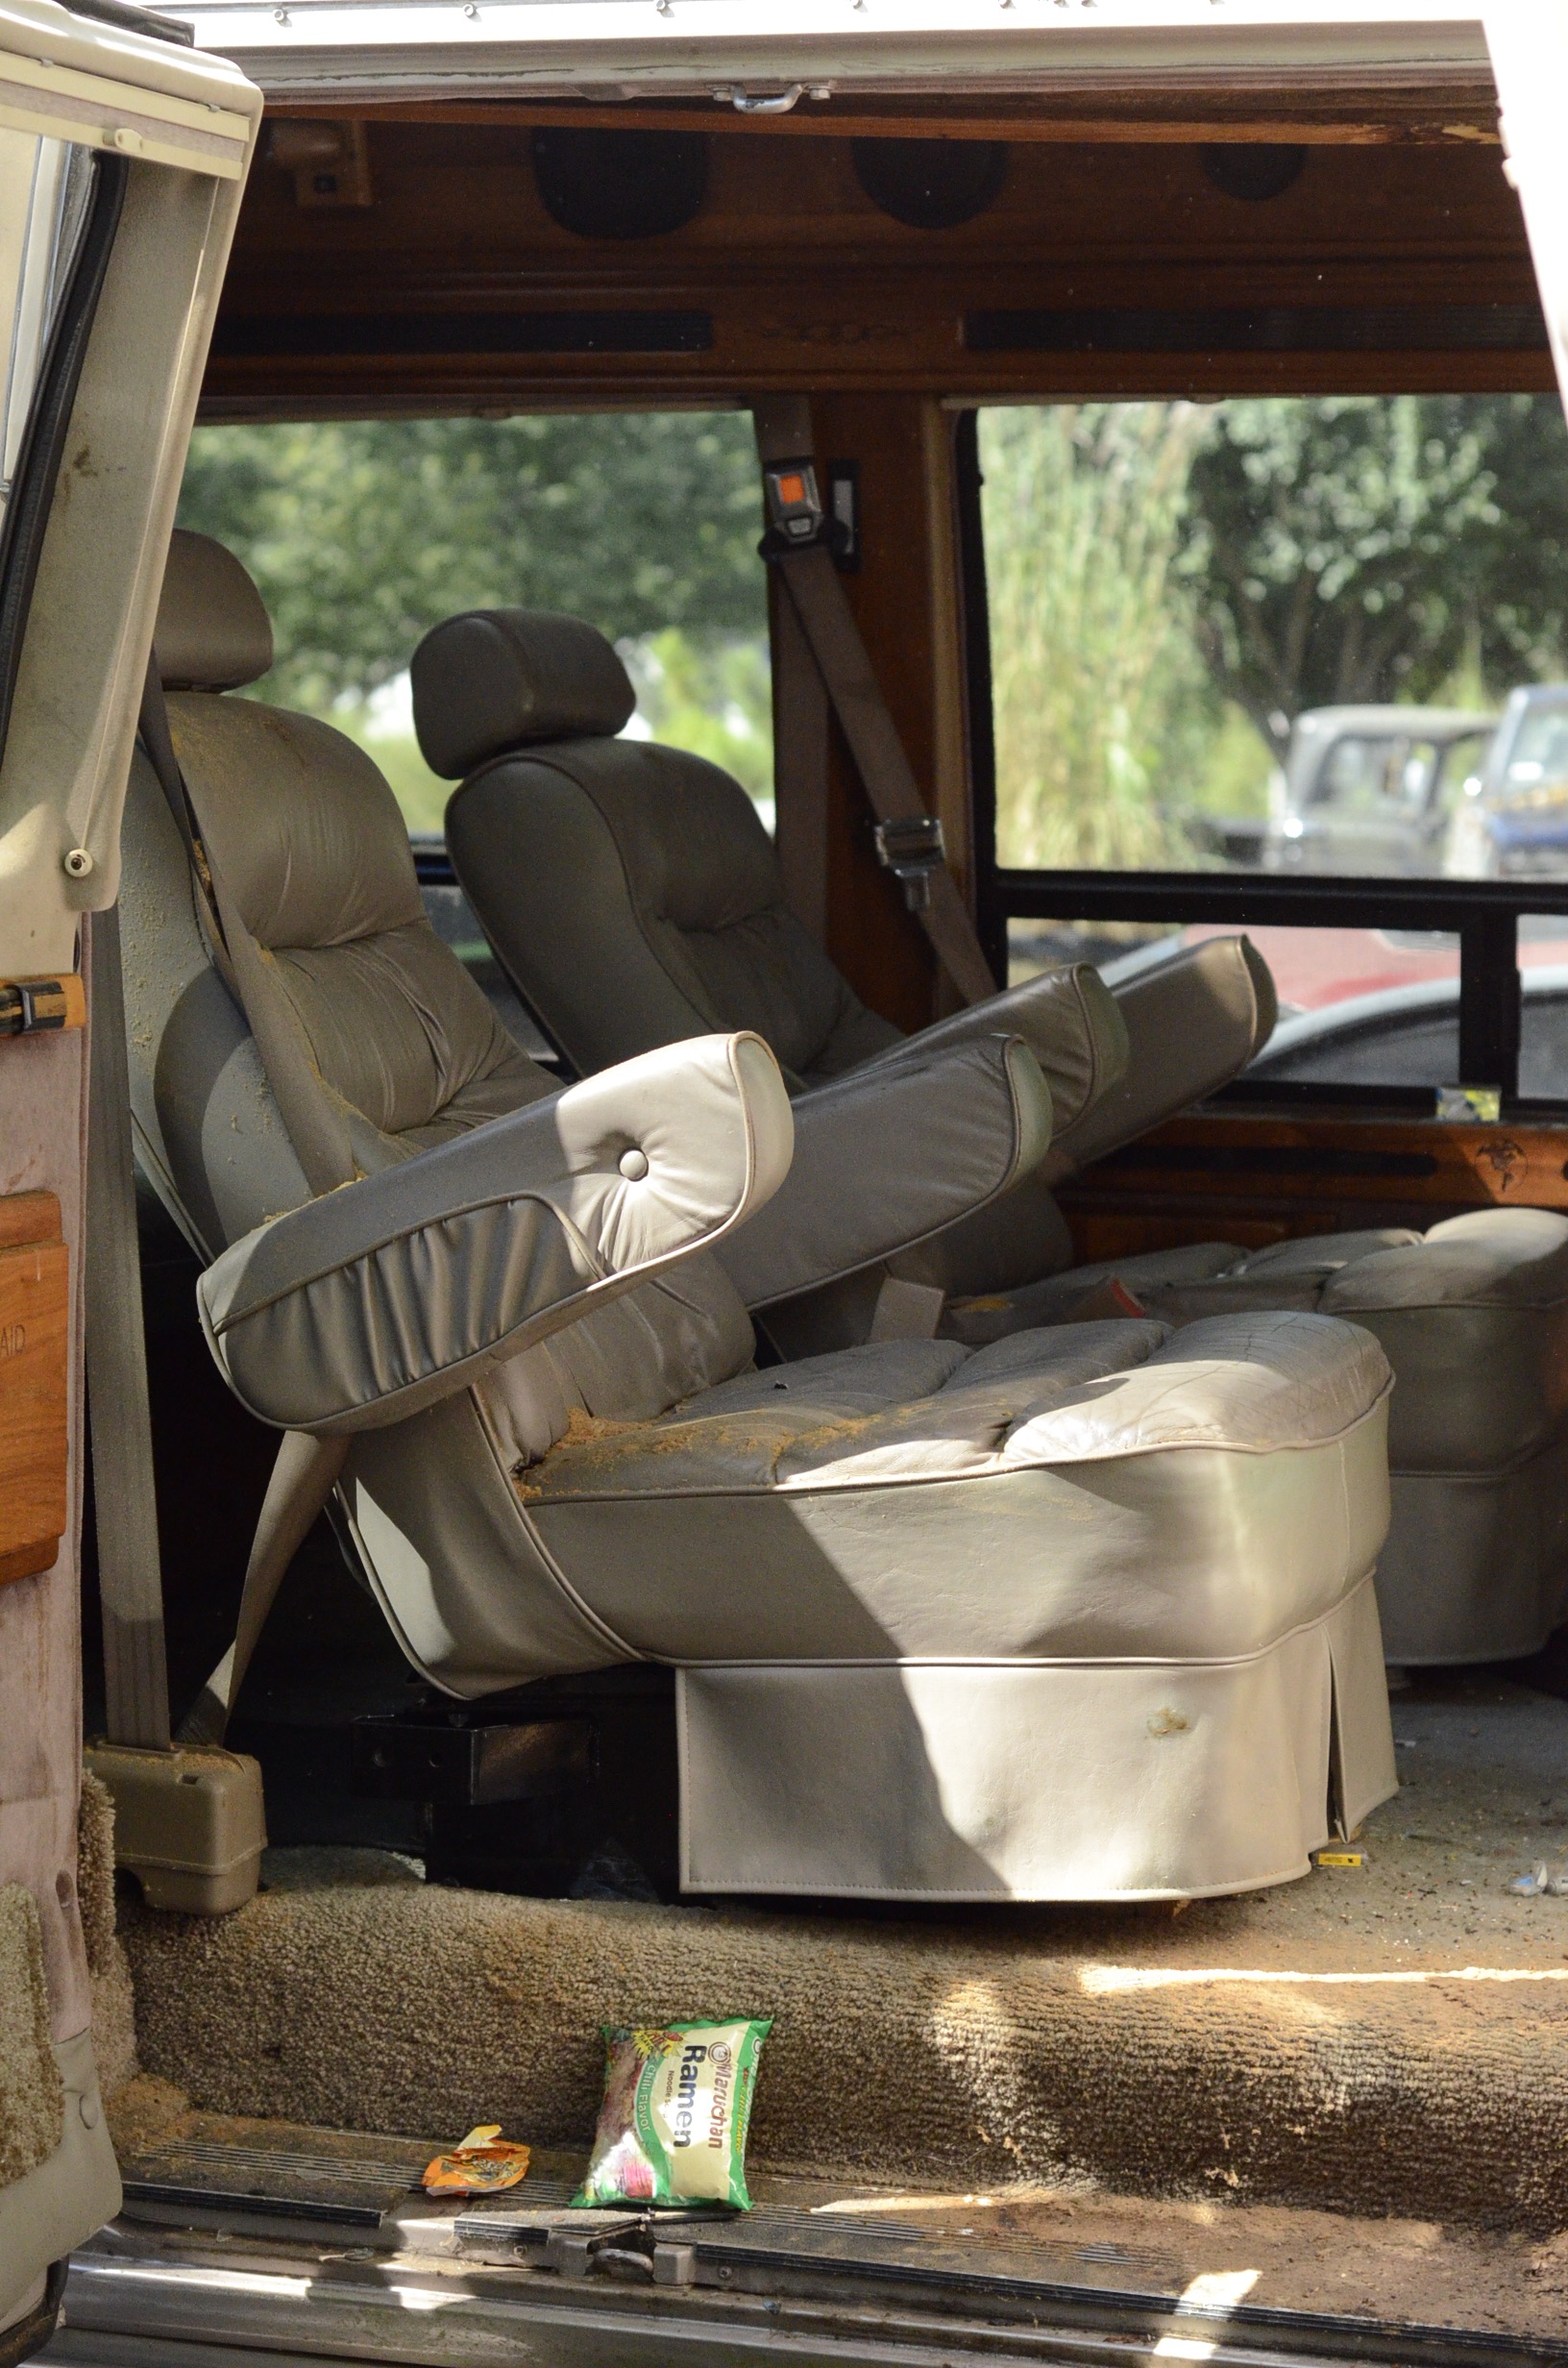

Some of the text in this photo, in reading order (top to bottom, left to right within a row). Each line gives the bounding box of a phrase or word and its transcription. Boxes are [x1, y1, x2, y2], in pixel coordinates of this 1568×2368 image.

[0, 1324, 26, 1356] AID
[638, 2064, 656, 2132] Chili Flavor
[665, 2070, 674, 2098] Noodle
[674, 2045, 708, 2148] Ramen
[708, 2061, 732, 2149] Maruchan
